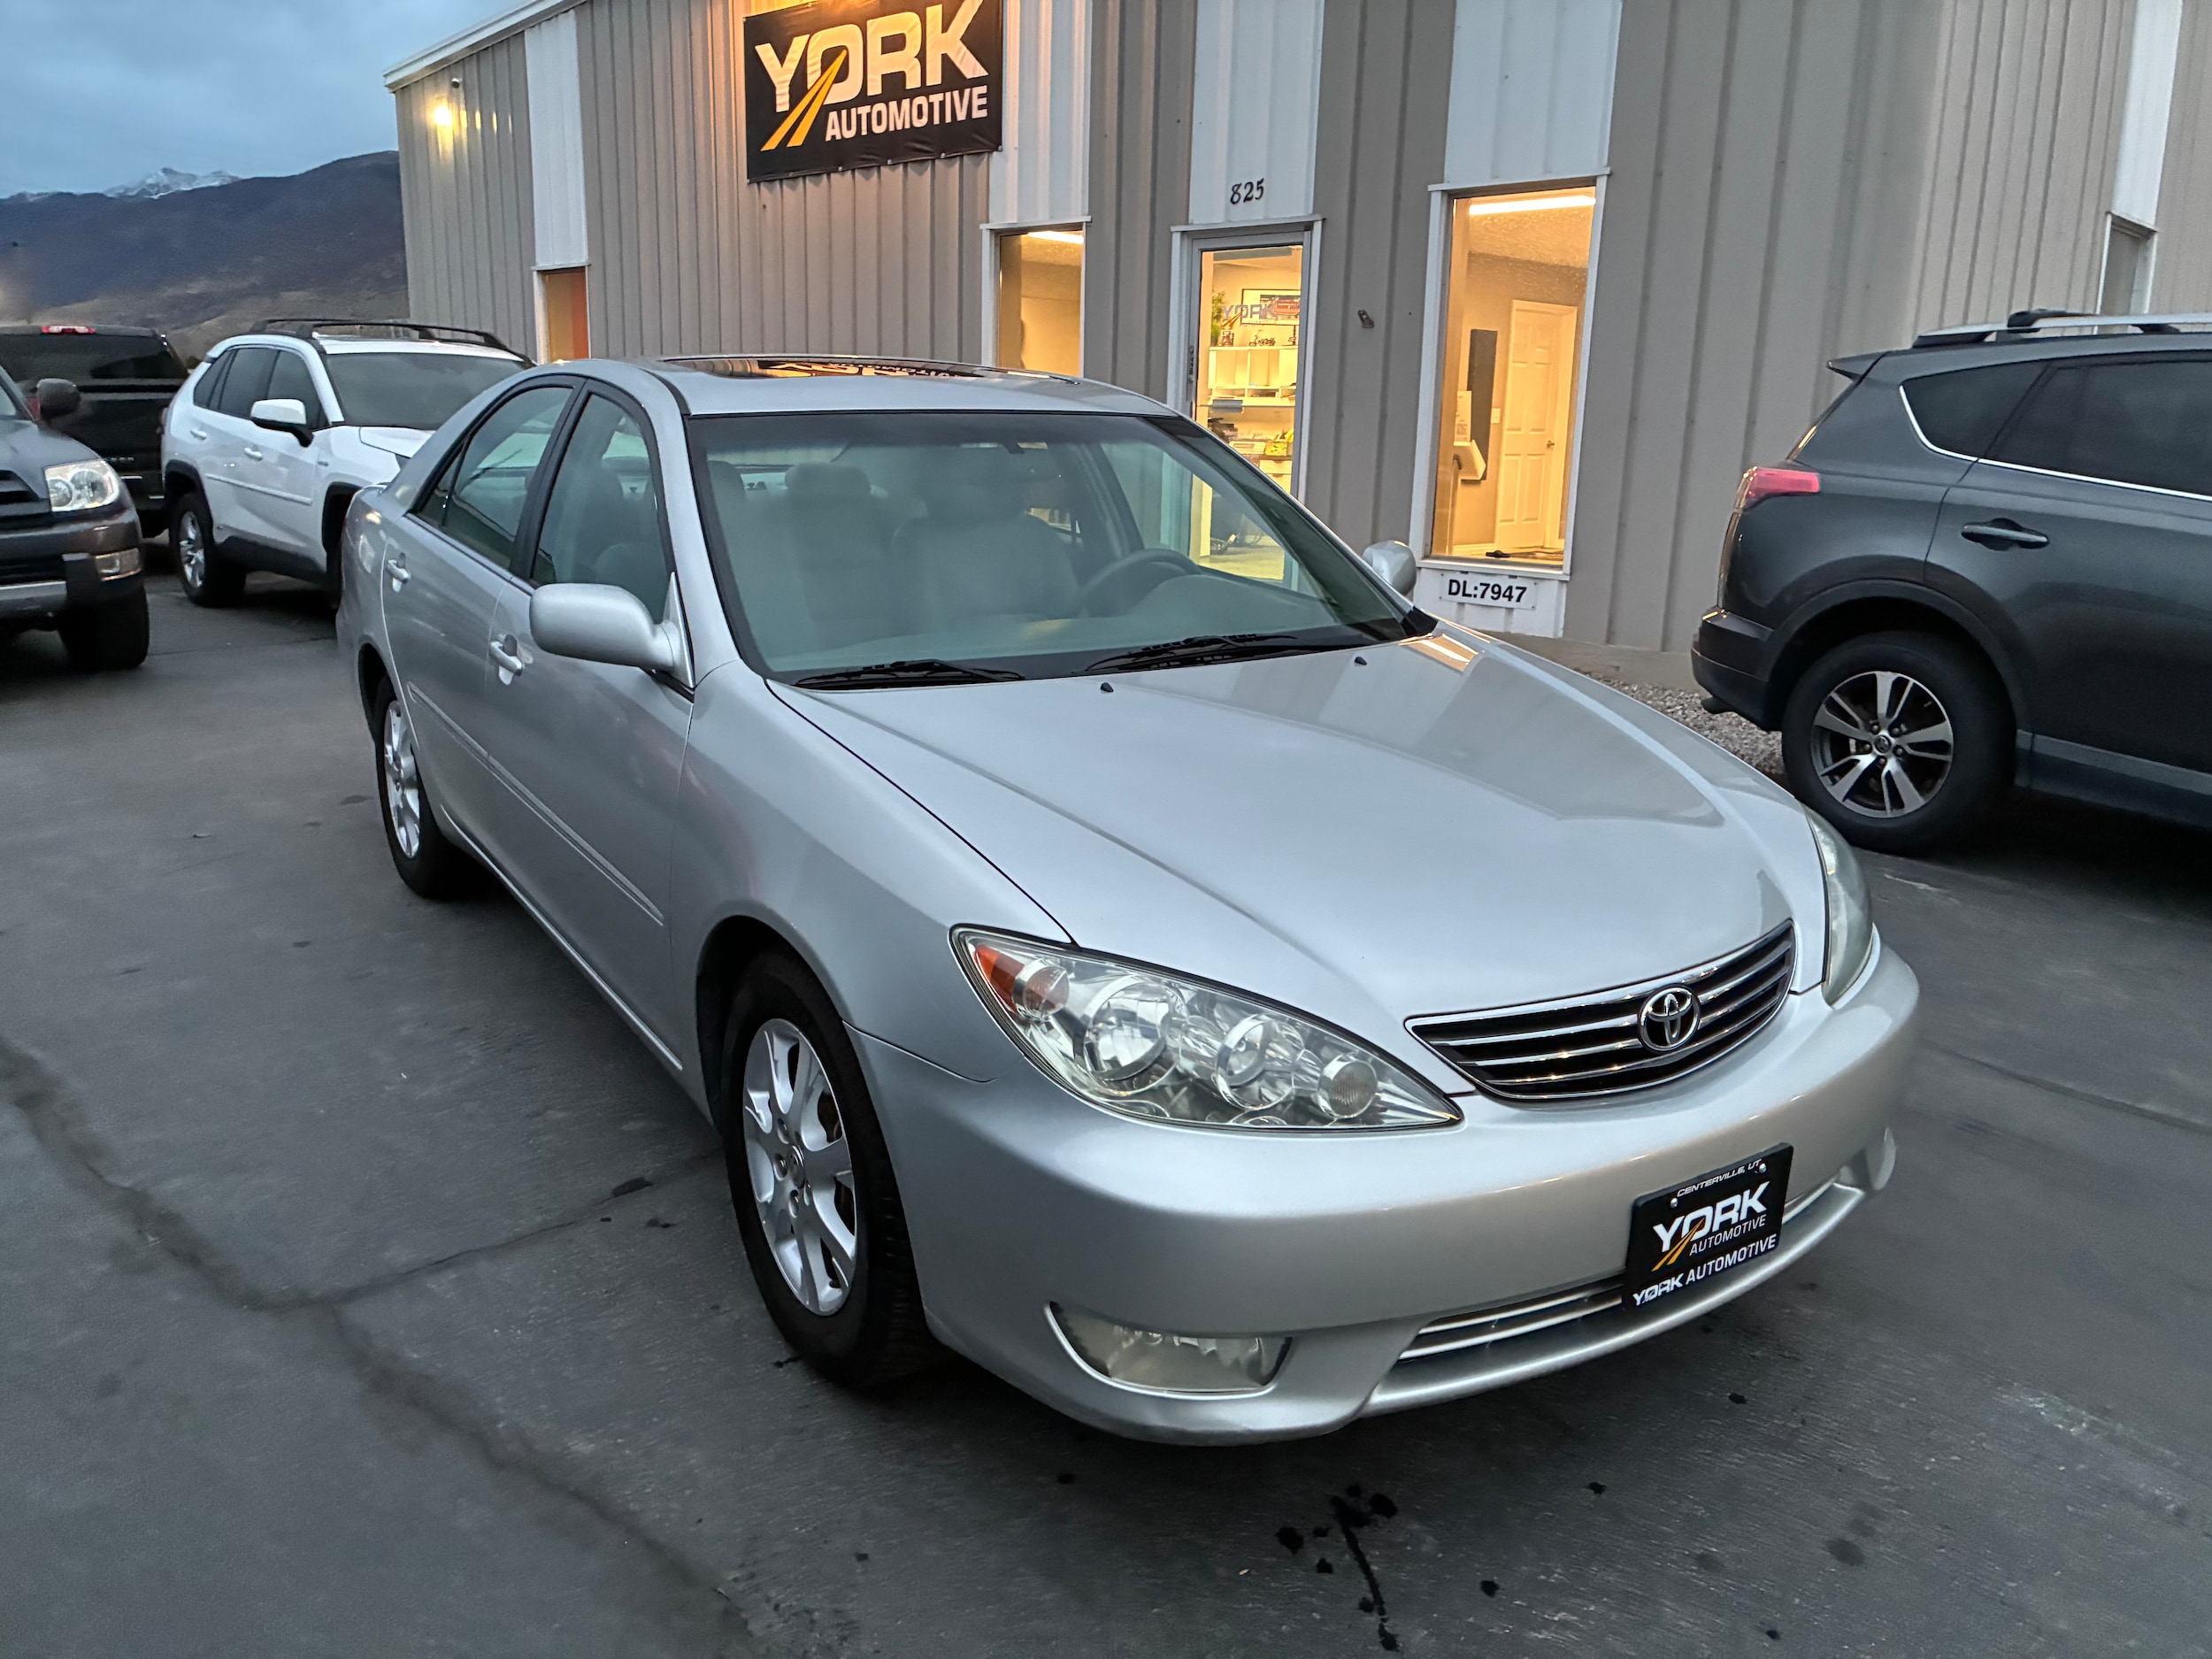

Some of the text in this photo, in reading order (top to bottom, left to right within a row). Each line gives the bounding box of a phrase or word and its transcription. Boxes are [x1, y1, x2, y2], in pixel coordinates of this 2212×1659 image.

[755, 0, 989, 112] YORK
[826, 85, 987, 142] AUTOMOTIVE
[1230, 178, 1264, 204] 825
[1448, 579, 1527, 603] DL:7947
[1747, 1158, 1763, 1170] UT
[1653, 1180, 1770, 1253] YORK
[1689, 1214, 1767, 1256] AUTOMOTIVE
[1632, 1233, 1778, 1306] YORK AUTOMOTIVE
